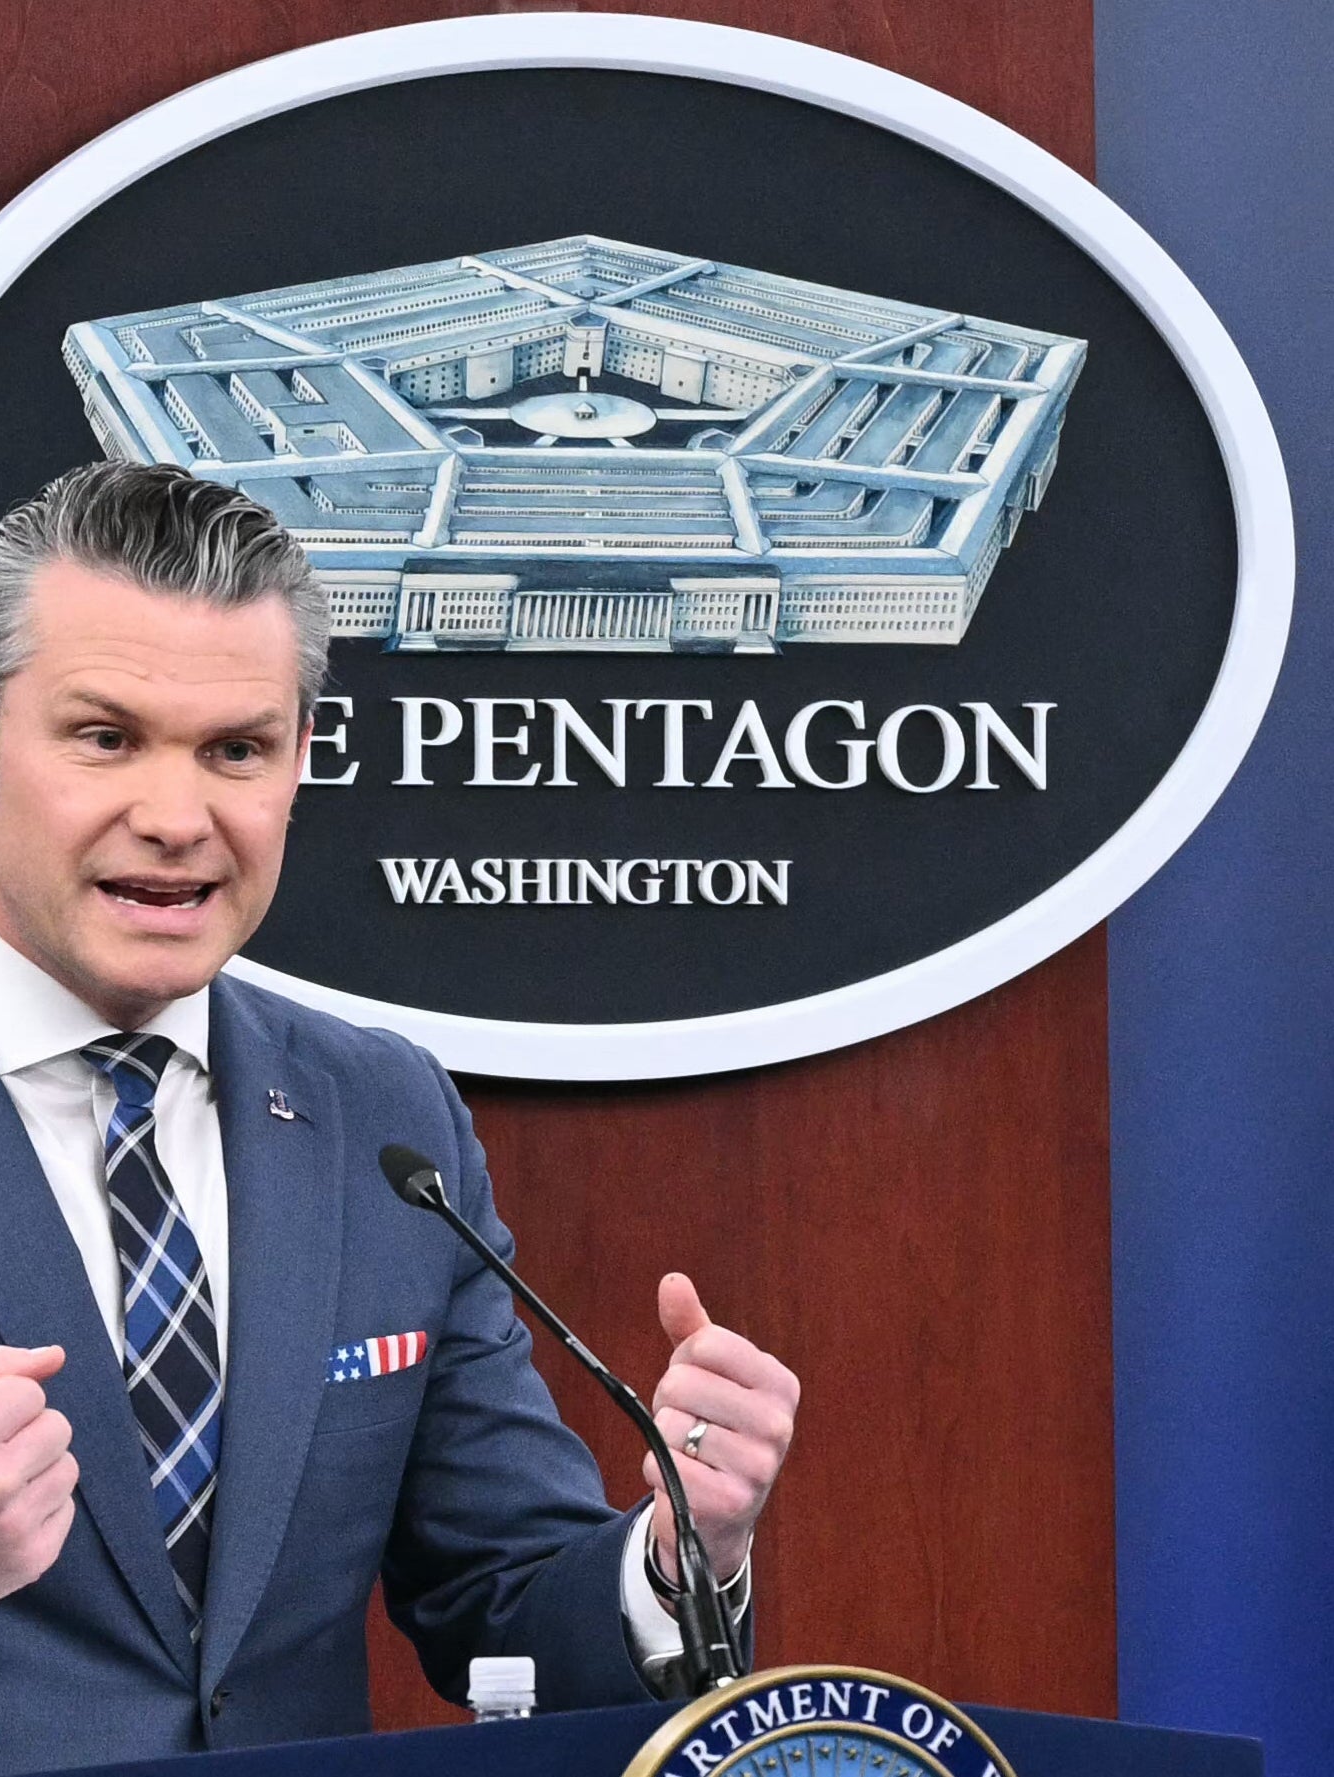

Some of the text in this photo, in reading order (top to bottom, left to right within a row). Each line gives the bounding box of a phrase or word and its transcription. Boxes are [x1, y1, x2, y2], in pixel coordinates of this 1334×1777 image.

[391, 696, 1058, 793] PENTAGON
[379, 858, 793, 905] WASHINGTON
[902, 1703, 962, 1753] OF
